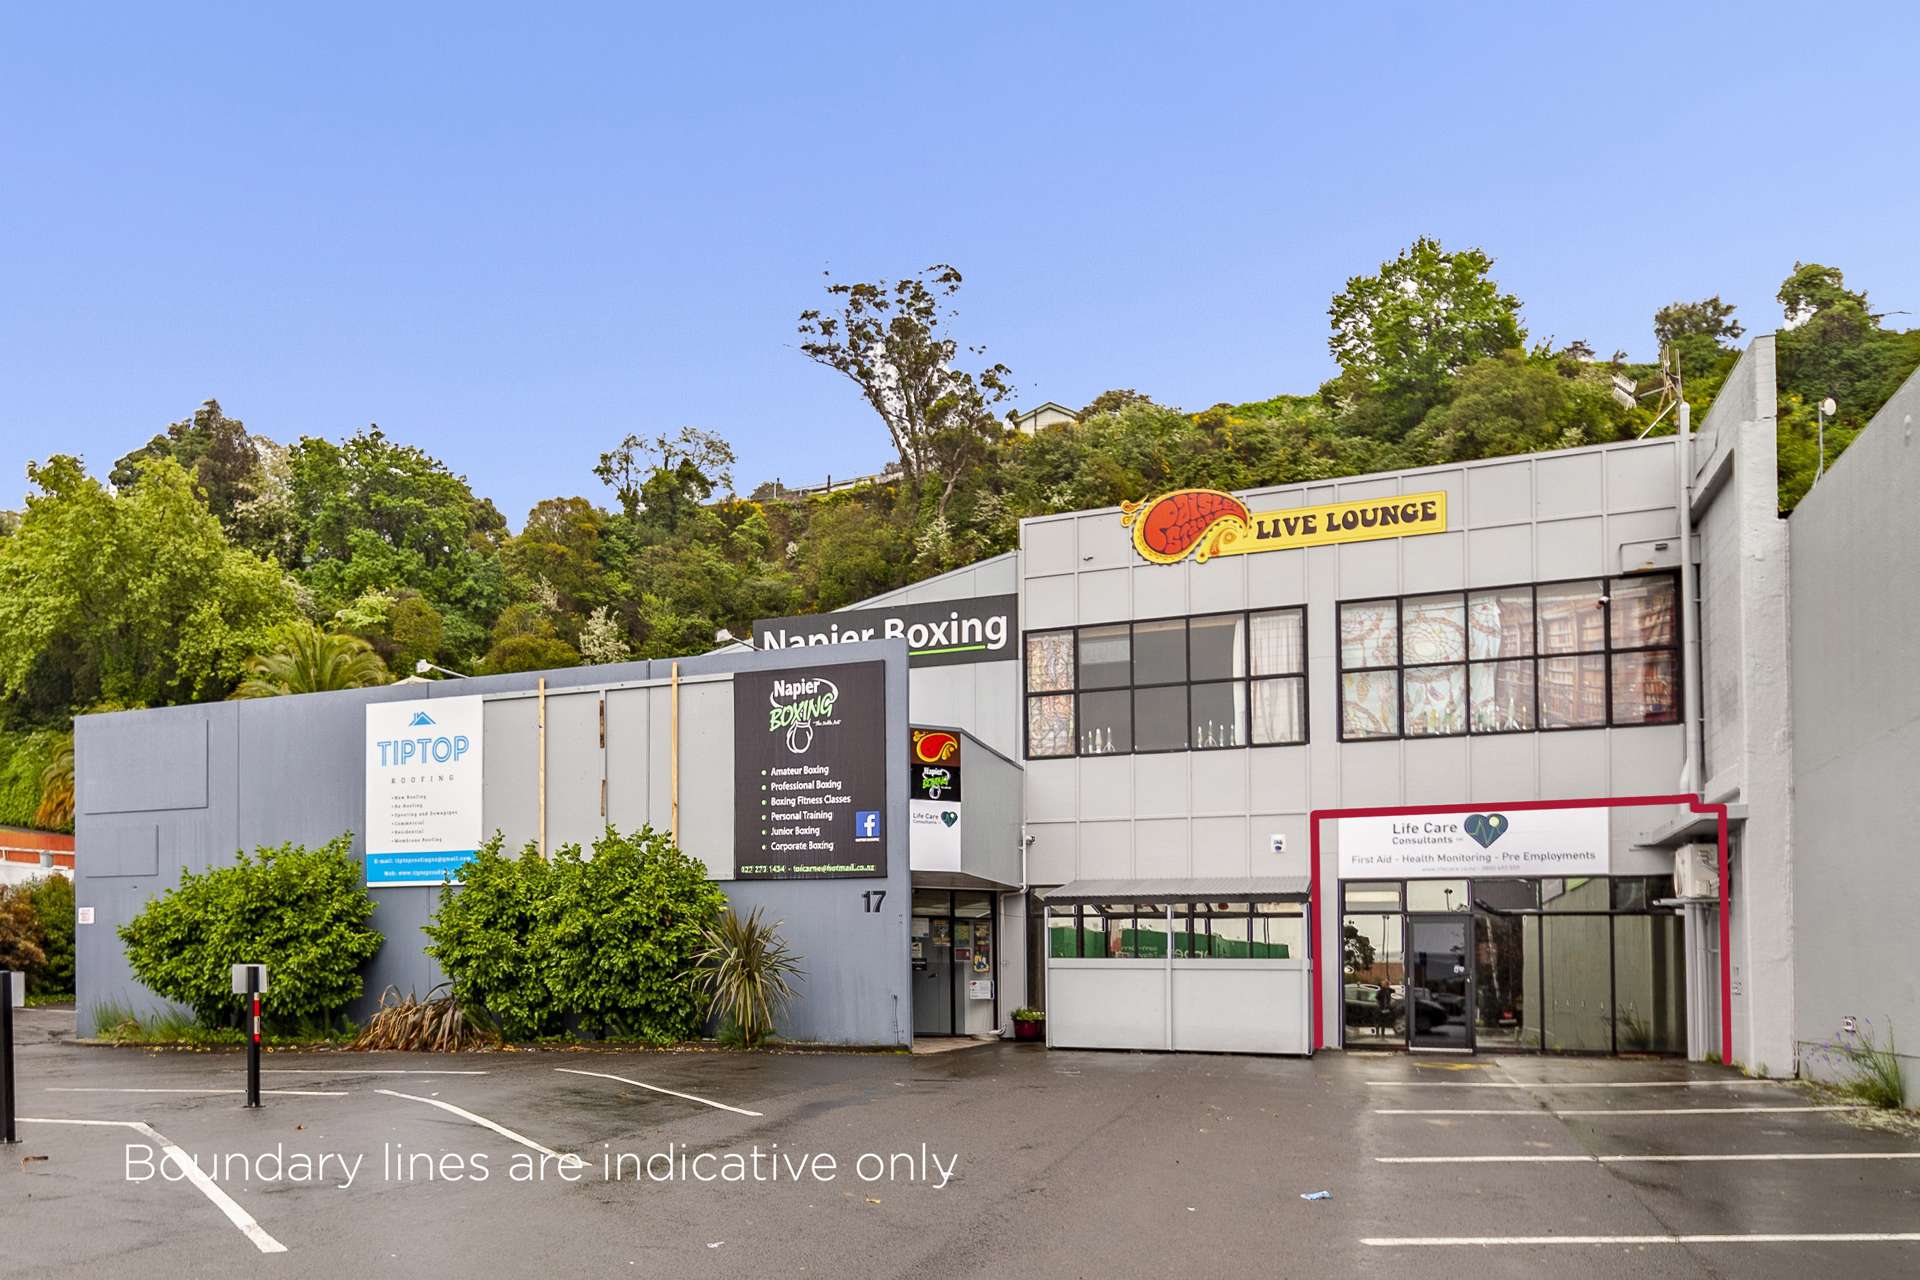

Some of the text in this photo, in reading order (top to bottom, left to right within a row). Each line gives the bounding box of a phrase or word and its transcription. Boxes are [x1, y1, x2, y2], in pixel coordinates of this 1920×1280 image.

[1256, 501, 1437, 539] LIVE LOUNGE
[884, 611, 1008, 650] Boxing
[773, 678, 820, 700] Napier
[769, 692, 833, 732] BOXING
[377, 735, 470, 767] TIPTOP
[771, 765, 829, 776] Amateur Boxing
[391, 774, 455, 784] ROOFING
[771, 779, 842, 791] Professional Boxing
[771, 794, 851, 807] Boxing Fitness Classes
[771, 810, 833, 821] Personal Training
[925, 813, 939, 821] Care
[771, 825, 820, 837] Junior Boxing
[1392, 821, 1458, 835] Life Care
[771, 841, 834, 852] Corporate Boxing
[1392, 836, 1454, 845] Consultants
[1352, 850, 1596, 865] First Aid Health Monitoring Pre Employments
[862, 890, 887, 913] 17
